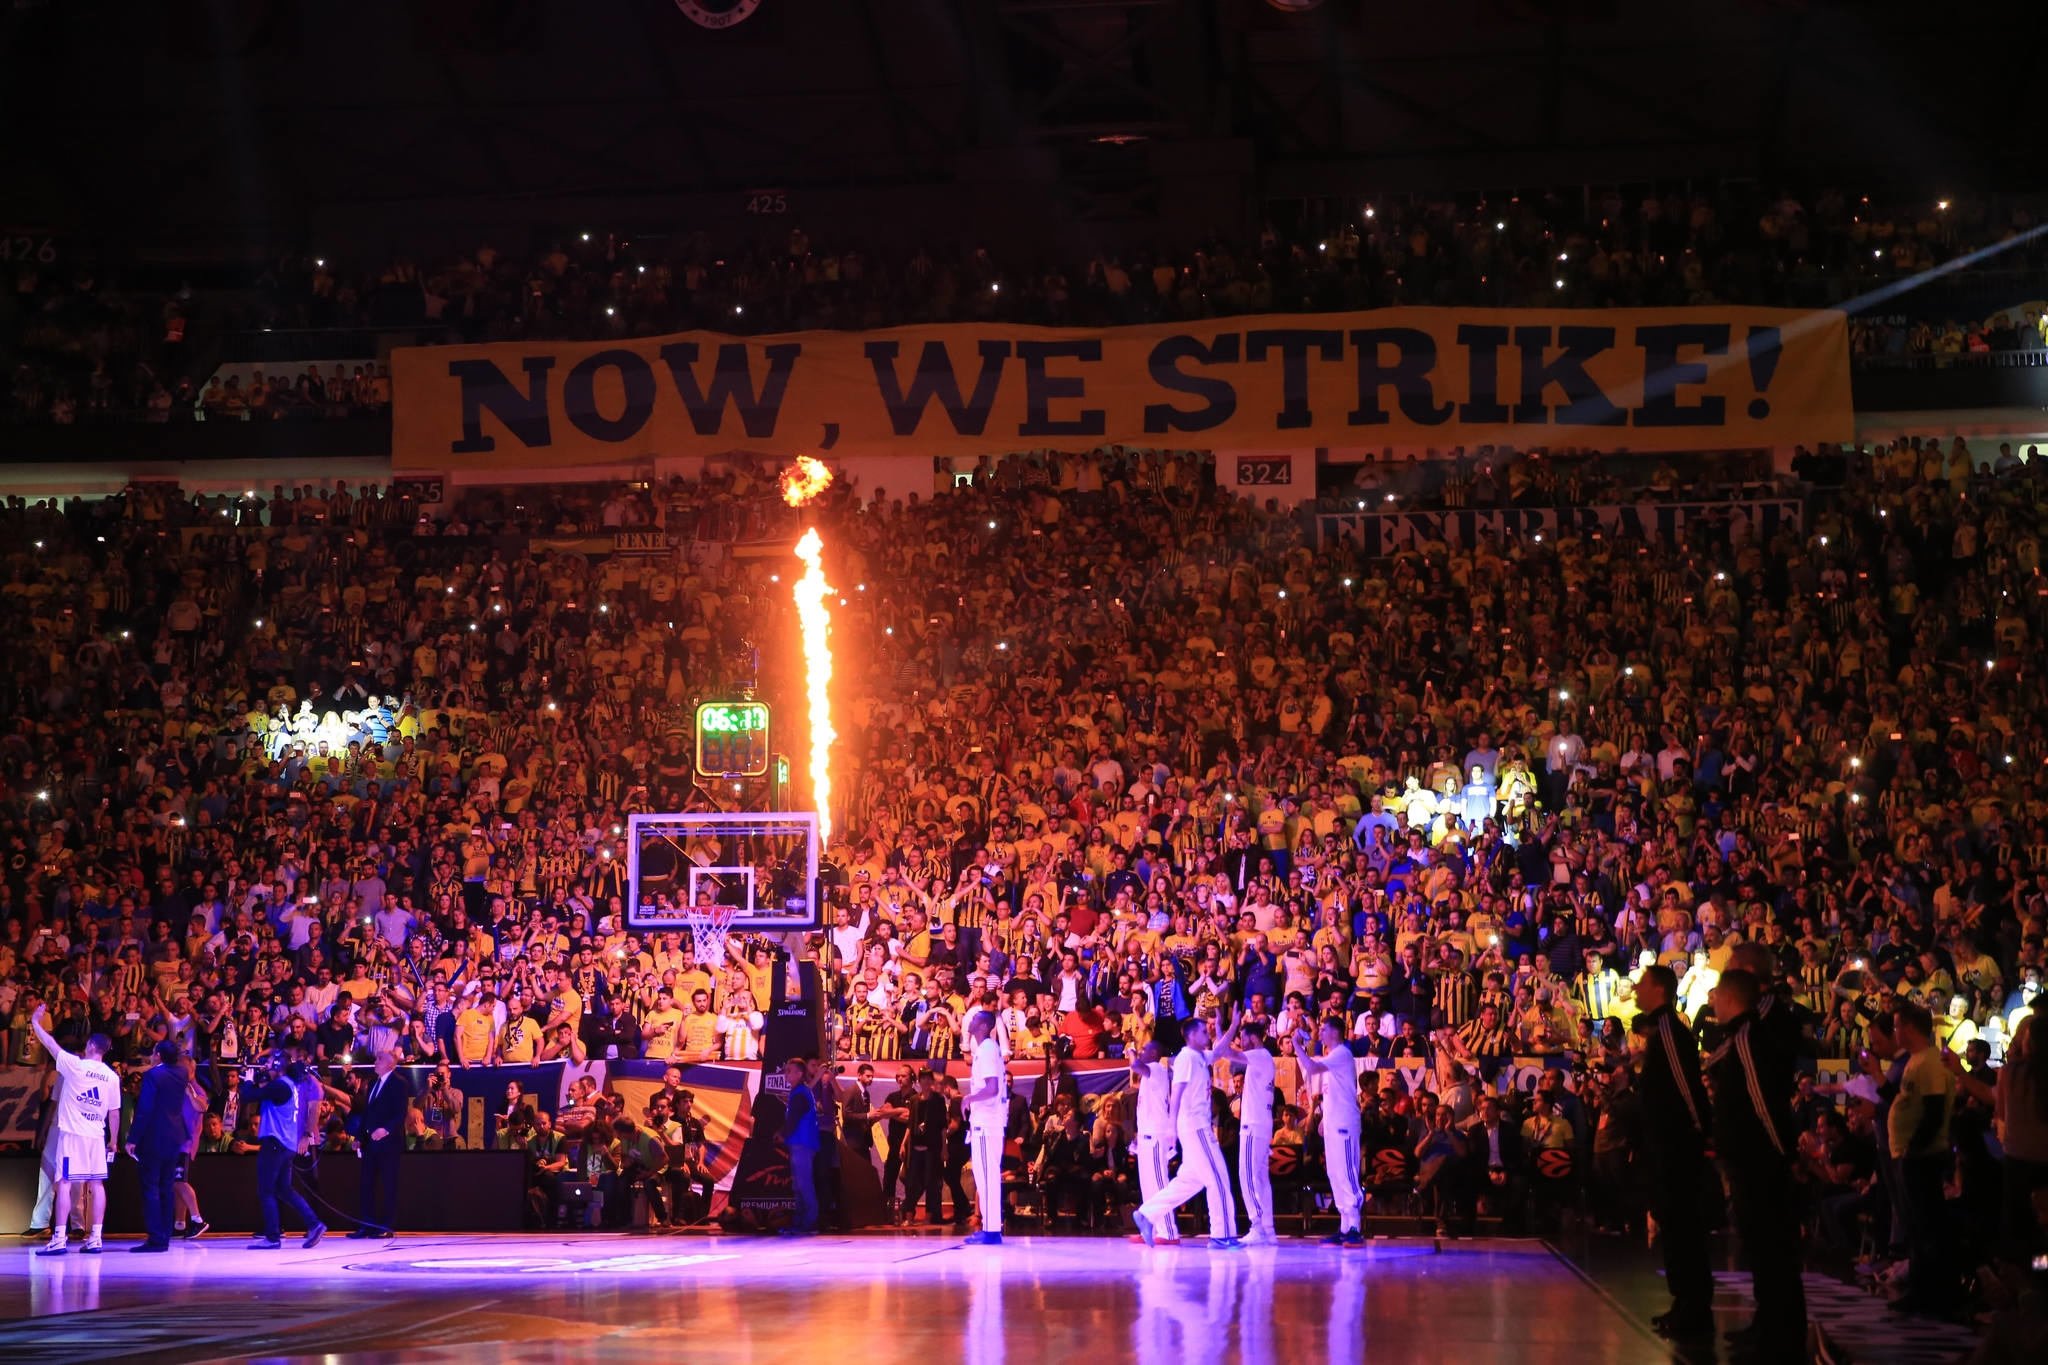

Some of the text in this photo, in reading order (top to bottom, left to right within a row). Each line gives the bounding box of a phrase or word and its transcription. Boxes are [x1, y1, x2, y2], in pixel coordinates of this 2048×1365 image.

[746, 195, 787, 214] 425
[0, 235, 57, 263] 426
[449, 323, 1785, 453] NOW, WE STRIKE!
[1239, 463, 1290, 484] 324
